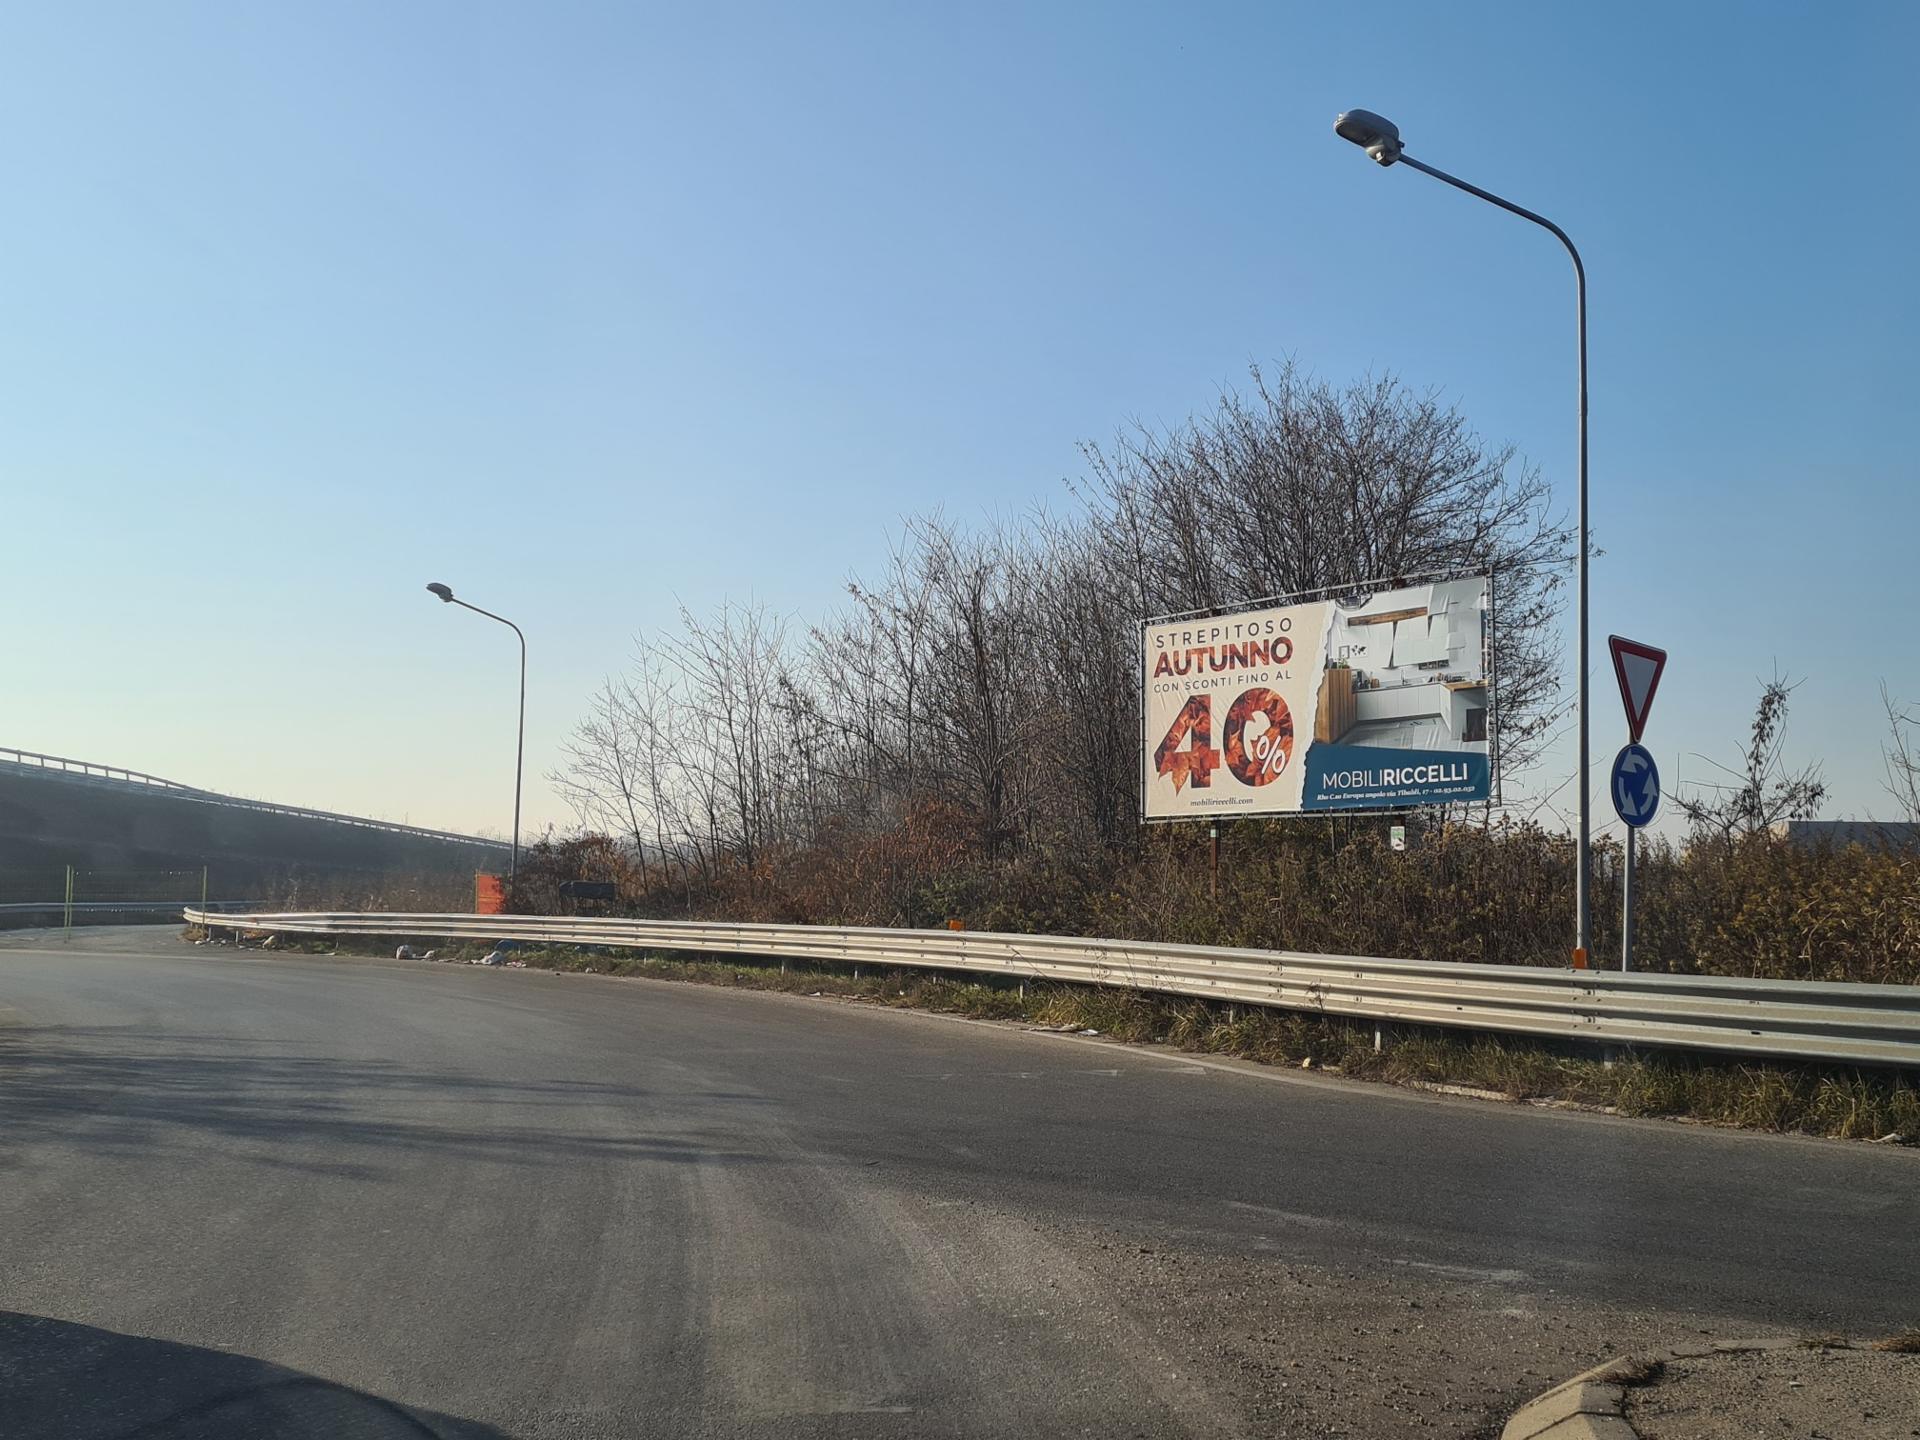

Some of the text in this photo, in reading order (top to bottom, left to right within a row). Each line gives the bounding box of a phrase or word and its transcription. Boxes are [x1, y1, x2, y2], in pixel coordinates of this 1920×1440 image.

[1156, 617, 1293, 649] STREPITOSO
[1153, 636, 1294, 678] AUTUNNO
[1153, 670, 1293, 694] CON SCONTI FINO AL
[1322, 762, 1468, 790] MOBILIRICCELLI
[1190, 796, 1254, 807] mobiliriccelli.com
[1343, 792, 1364, 800] Europa
[1365, 790, 1386, 799] angolo
